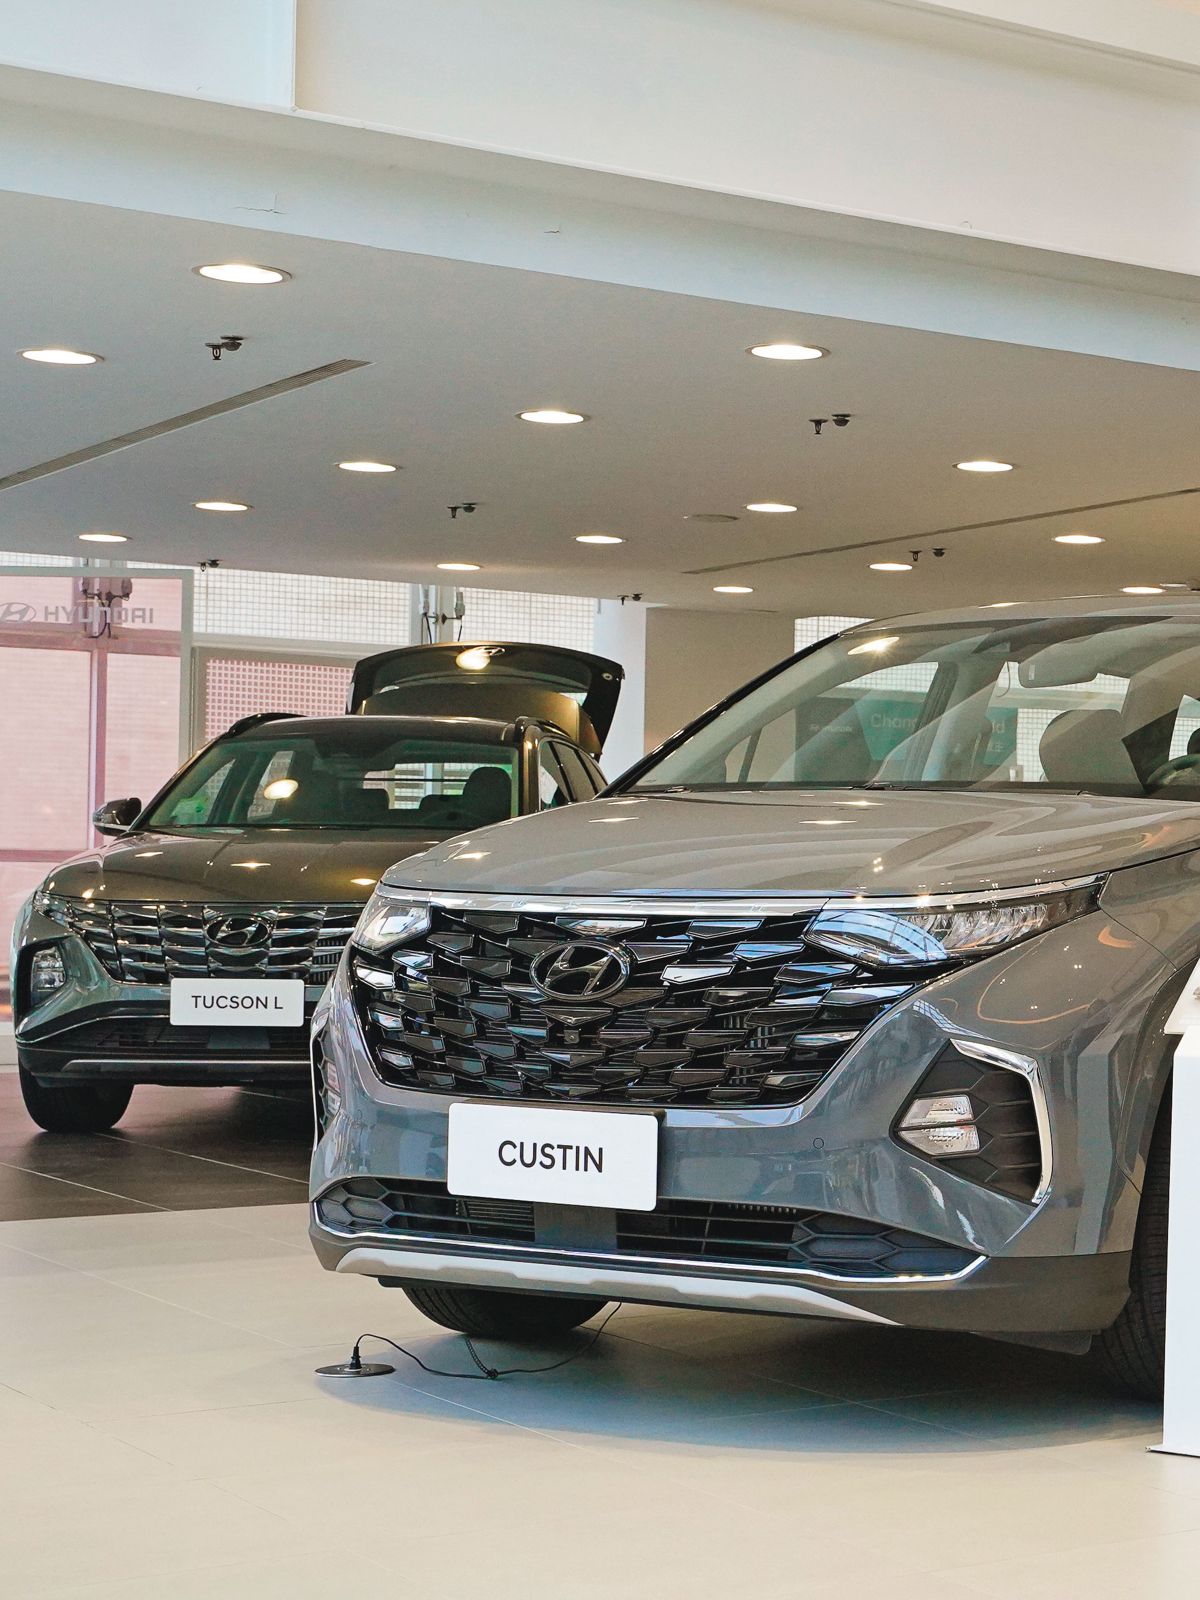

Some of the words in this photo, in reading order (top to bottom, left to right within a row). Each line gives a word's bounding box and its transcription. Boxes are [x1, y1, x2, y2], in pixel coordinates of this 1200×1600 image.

[44, 605, 154, 624] HYUNDAI
[191, 995, 268, 1010] TUCSON
[274, 996, 284, 1010] L
[498, 1140, 603, 1173] CUSTIN
